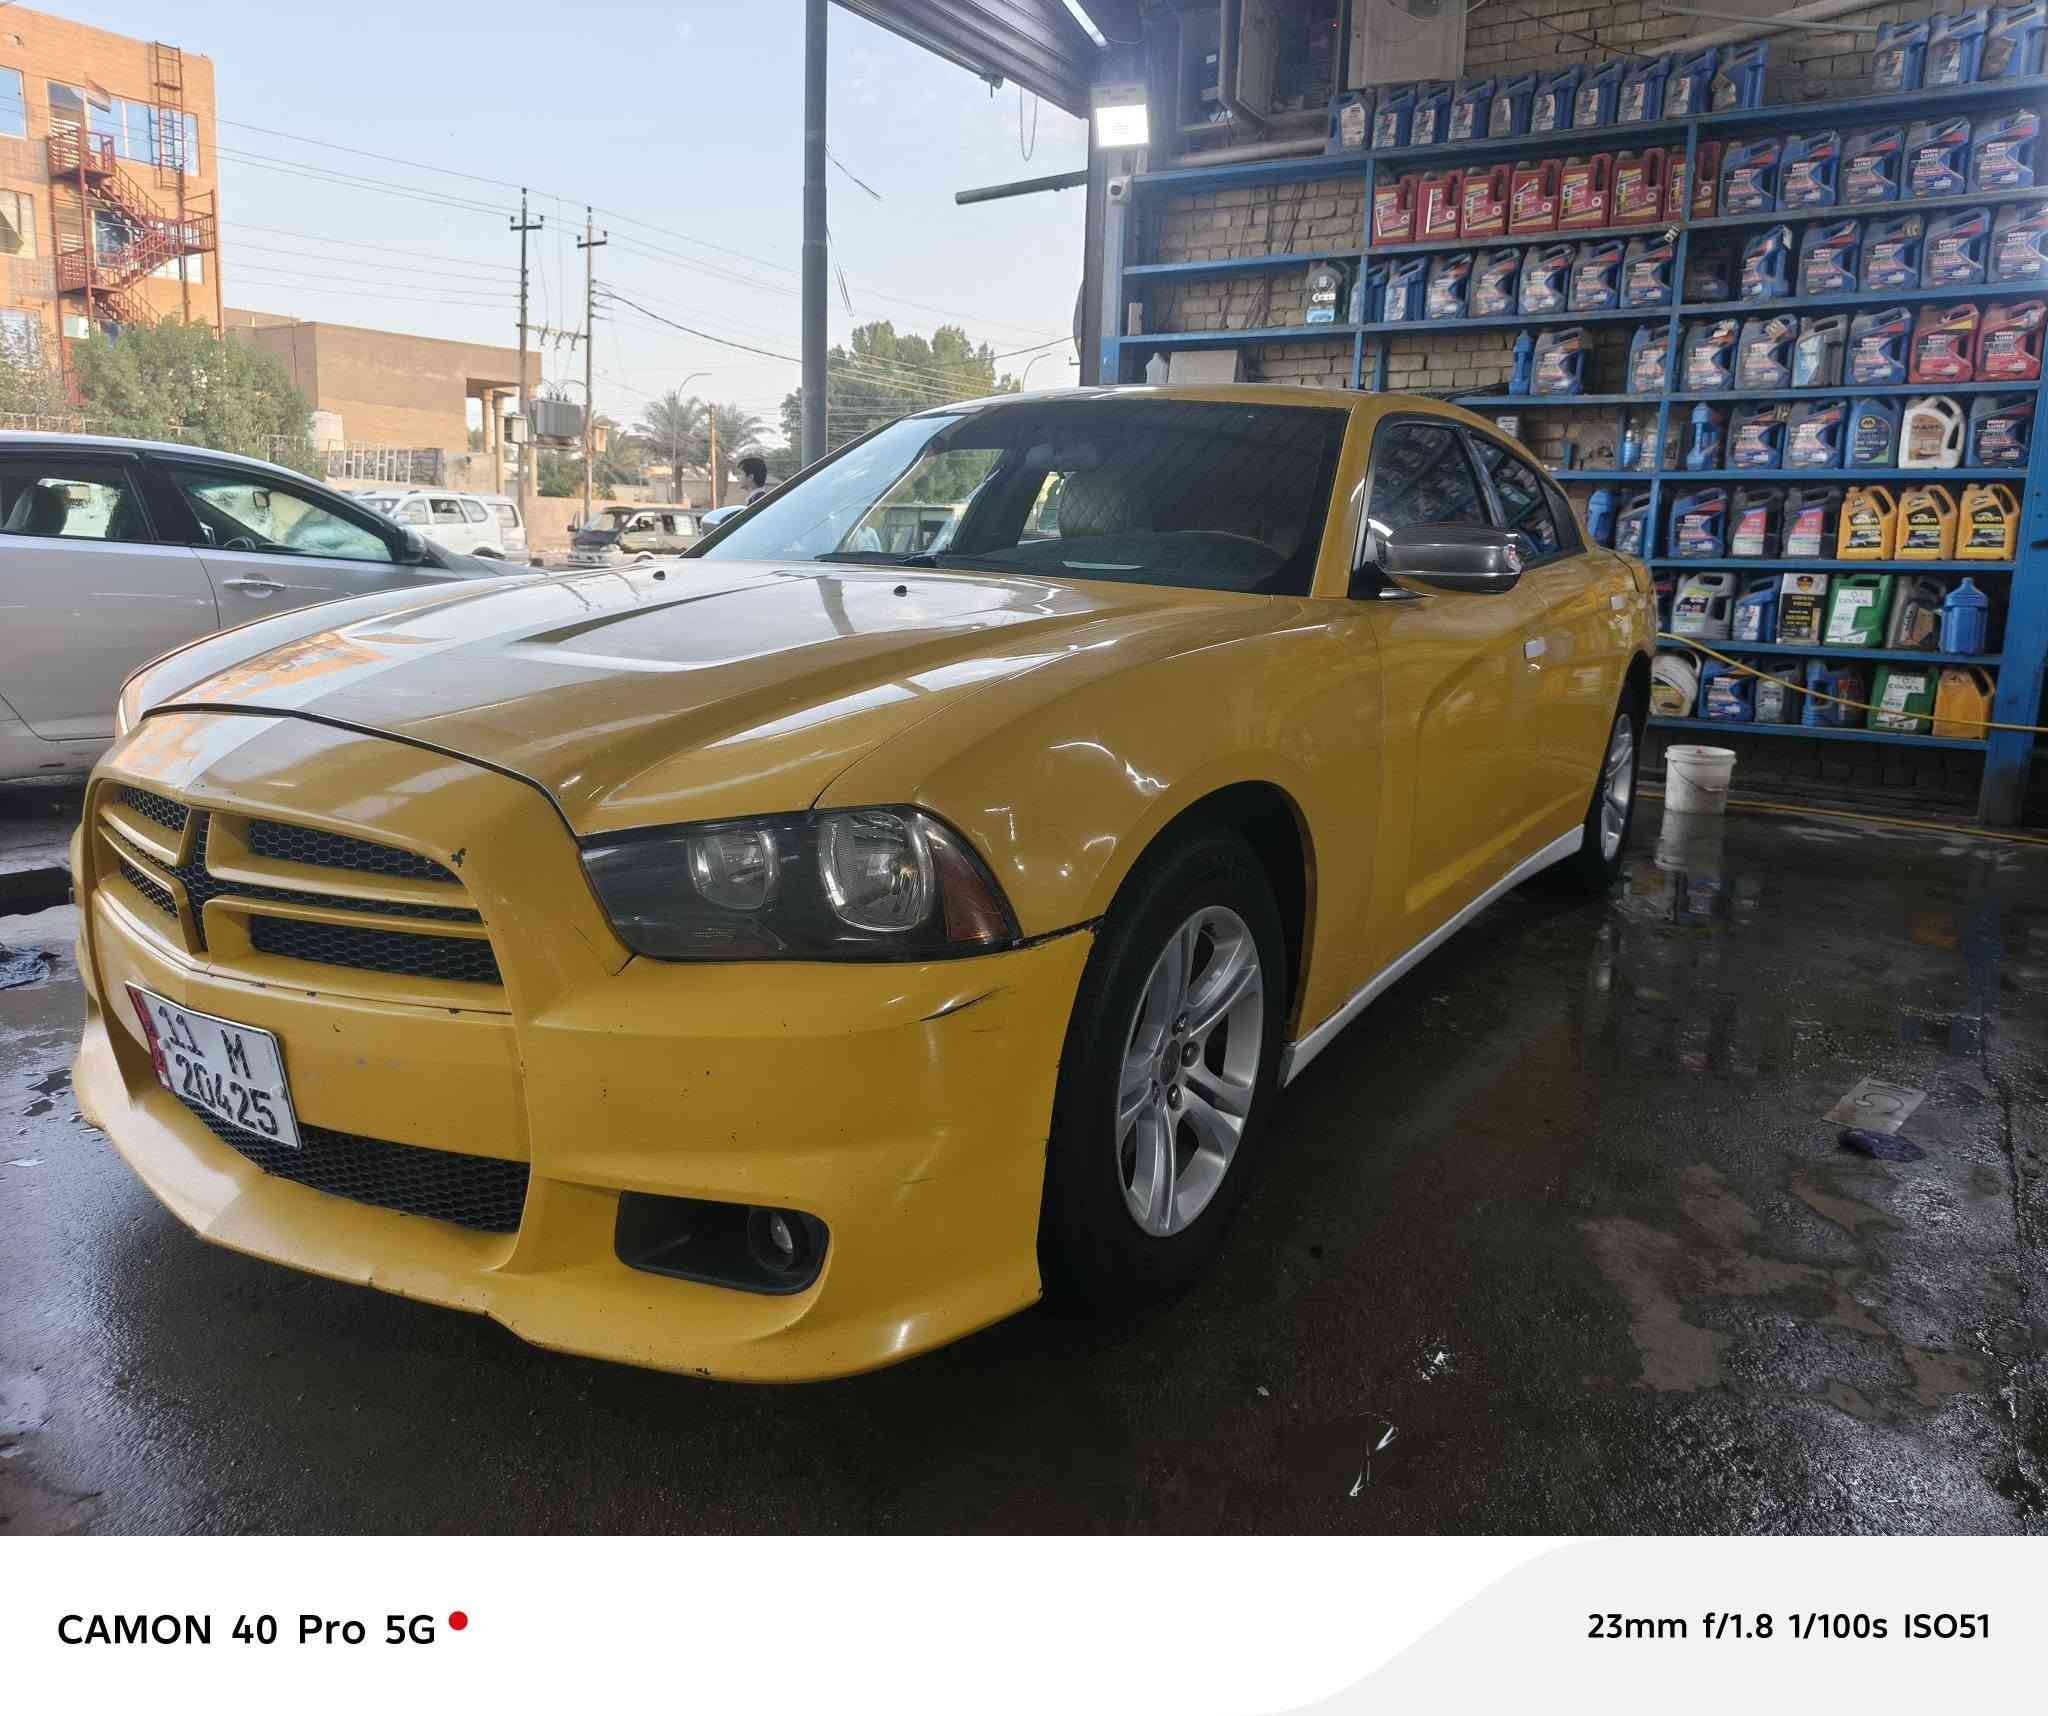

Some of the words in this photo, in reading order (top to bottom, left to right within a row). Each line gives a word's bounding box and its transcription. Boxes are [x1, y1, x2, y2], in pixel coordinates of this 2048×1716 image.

[158, 1005, 205, 1058] 11
[221, 1028, 251, 1080] M
[175, 1053, 279, 1136] 20425
